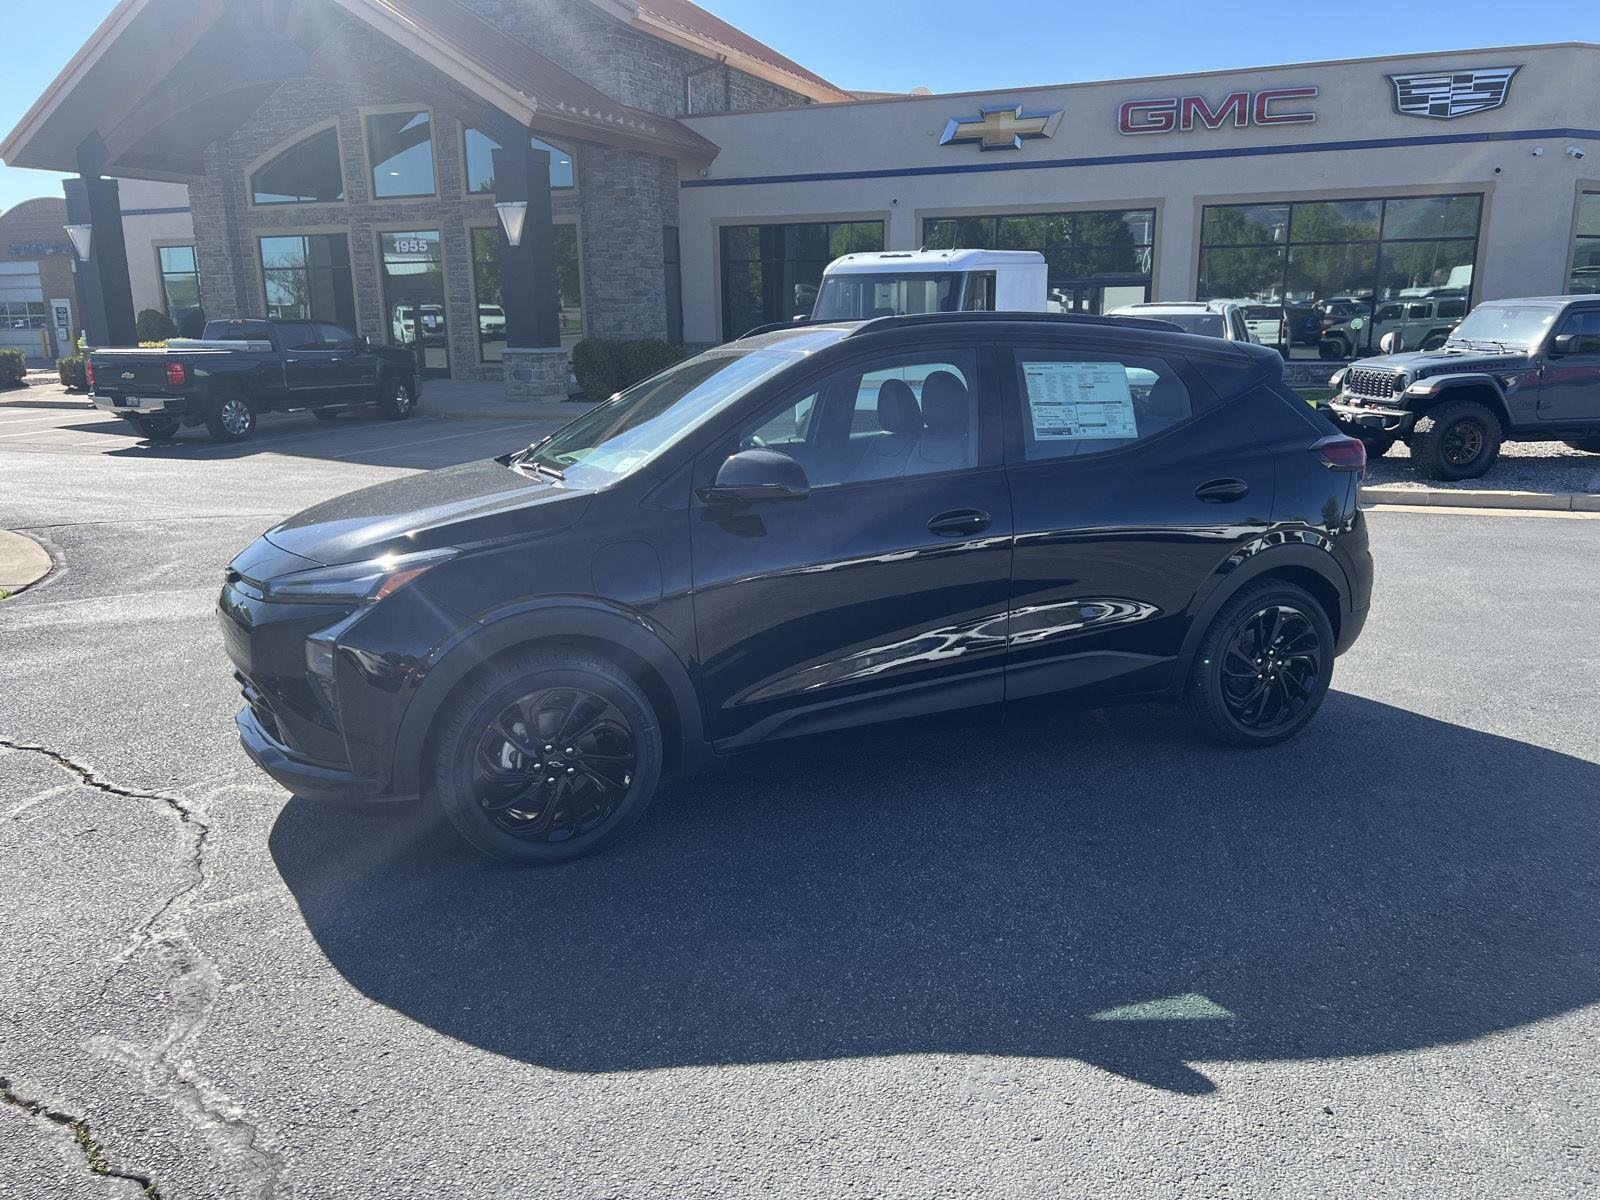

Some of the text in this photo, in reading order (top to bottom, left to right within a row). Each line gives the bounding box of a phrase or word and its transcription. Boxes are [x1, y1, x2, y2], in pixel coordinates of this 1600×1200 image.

[1118, 87, 1318, 136] GMC
[393, 240, 428, 253] 1955
[1431, 363, 1506, 374] RUBICON
